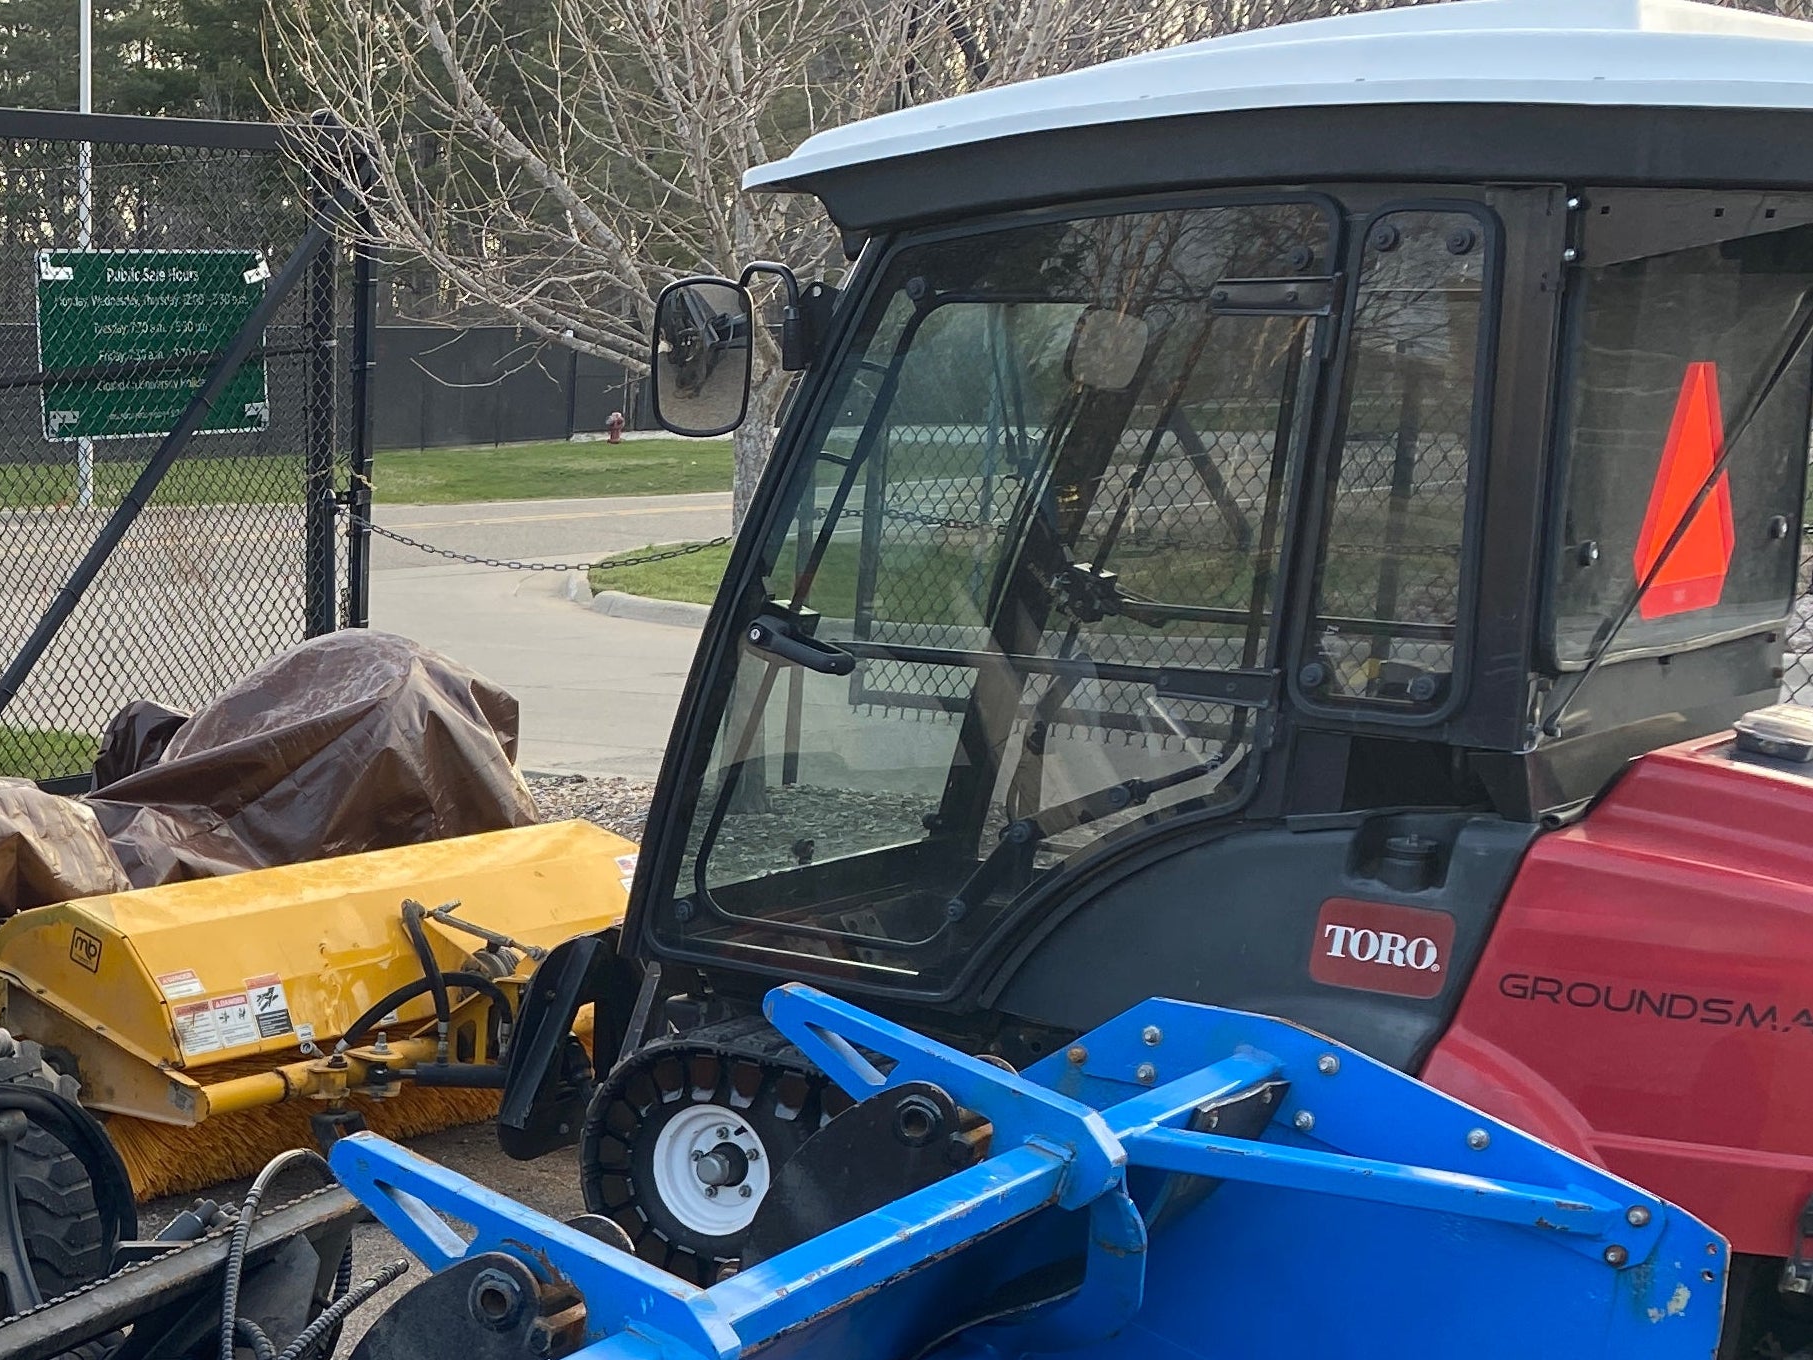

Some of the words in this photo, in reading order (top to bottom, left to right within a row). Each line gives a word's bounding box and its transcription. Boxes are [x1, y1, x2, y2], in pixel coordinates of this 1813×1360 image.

[106, 266, 139, 283] Public
[142, 266, 166, 283] Sale
[168, 267, 200, 283] Hours
[1324, 924, 1438, 970] TORO
